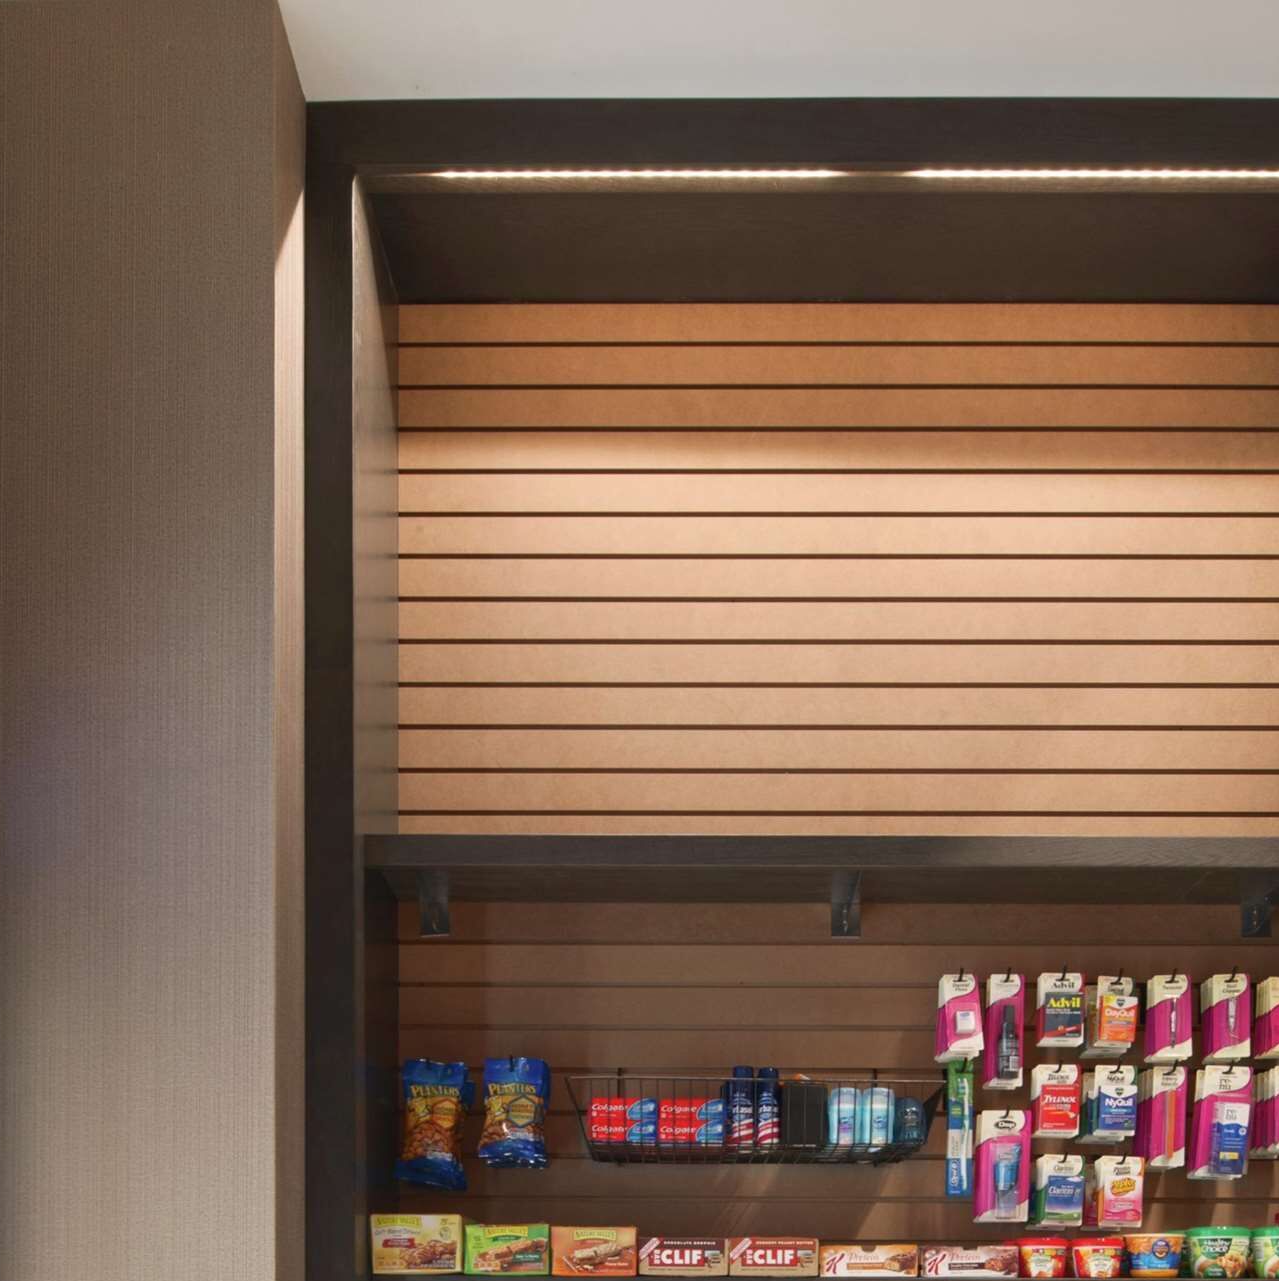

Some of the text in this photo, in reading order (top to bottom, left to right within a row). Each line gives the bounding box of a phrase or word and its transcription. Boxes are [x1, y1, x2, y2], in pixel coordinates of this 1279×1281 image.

[1052, 981, 1075, 989] Advil
[1047, 996, 1081, 1009] Advil
[662, 1250, 703, 1265] CLIF
[753, 1250, 795, 1265] CLIF
[825, 1253, 845, 1275] K
[927, 1253, 947, 1276] K
